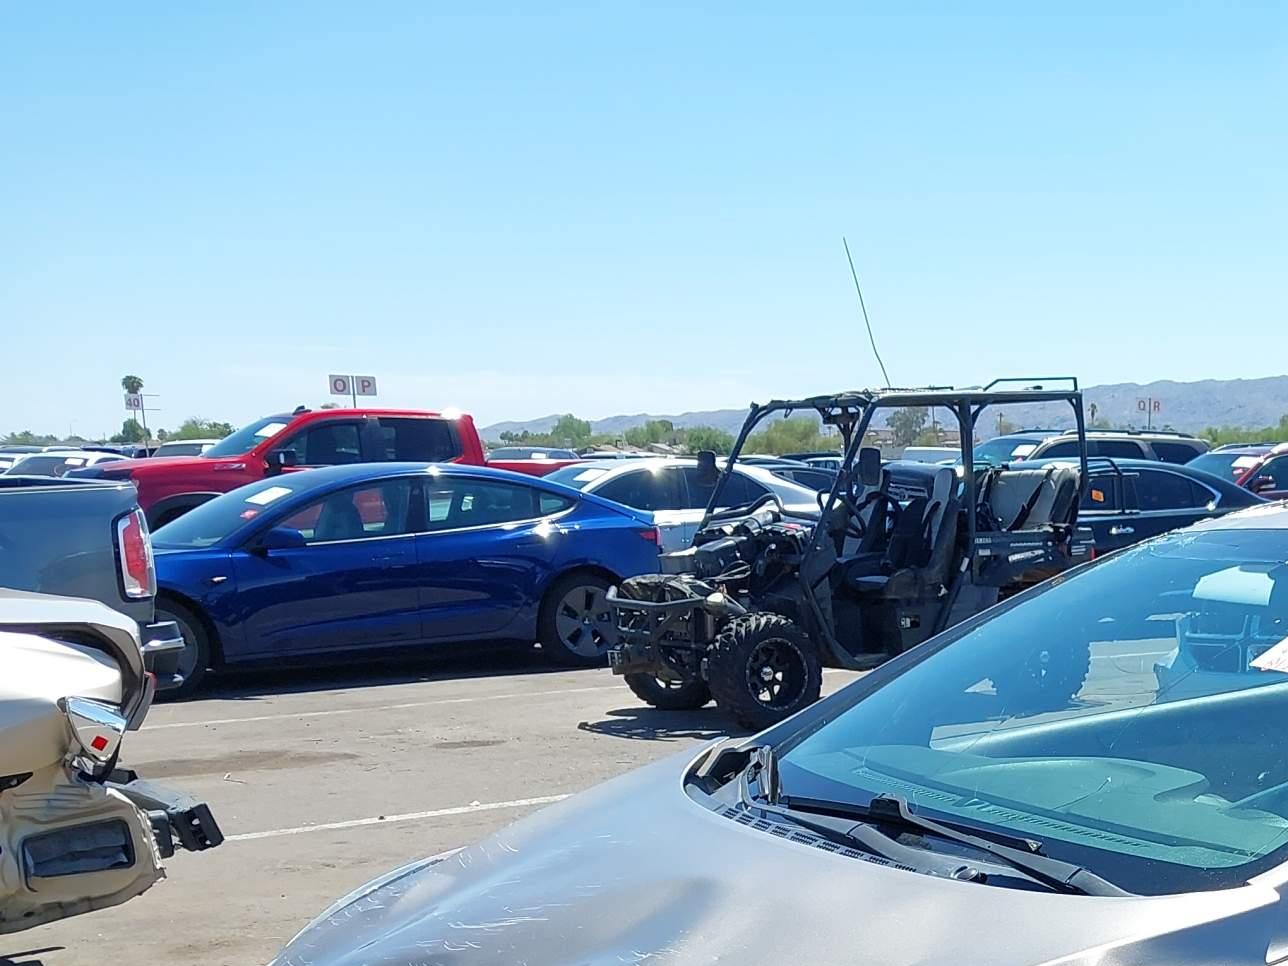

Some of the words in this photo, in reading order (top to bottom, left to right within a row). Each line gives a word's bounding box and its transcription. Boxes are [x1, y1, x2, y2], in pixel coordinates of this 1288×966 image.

[333, 378, 347, 393] O
[361, 379, 372, 393] P
[1153, 400, 1161, 411] R
